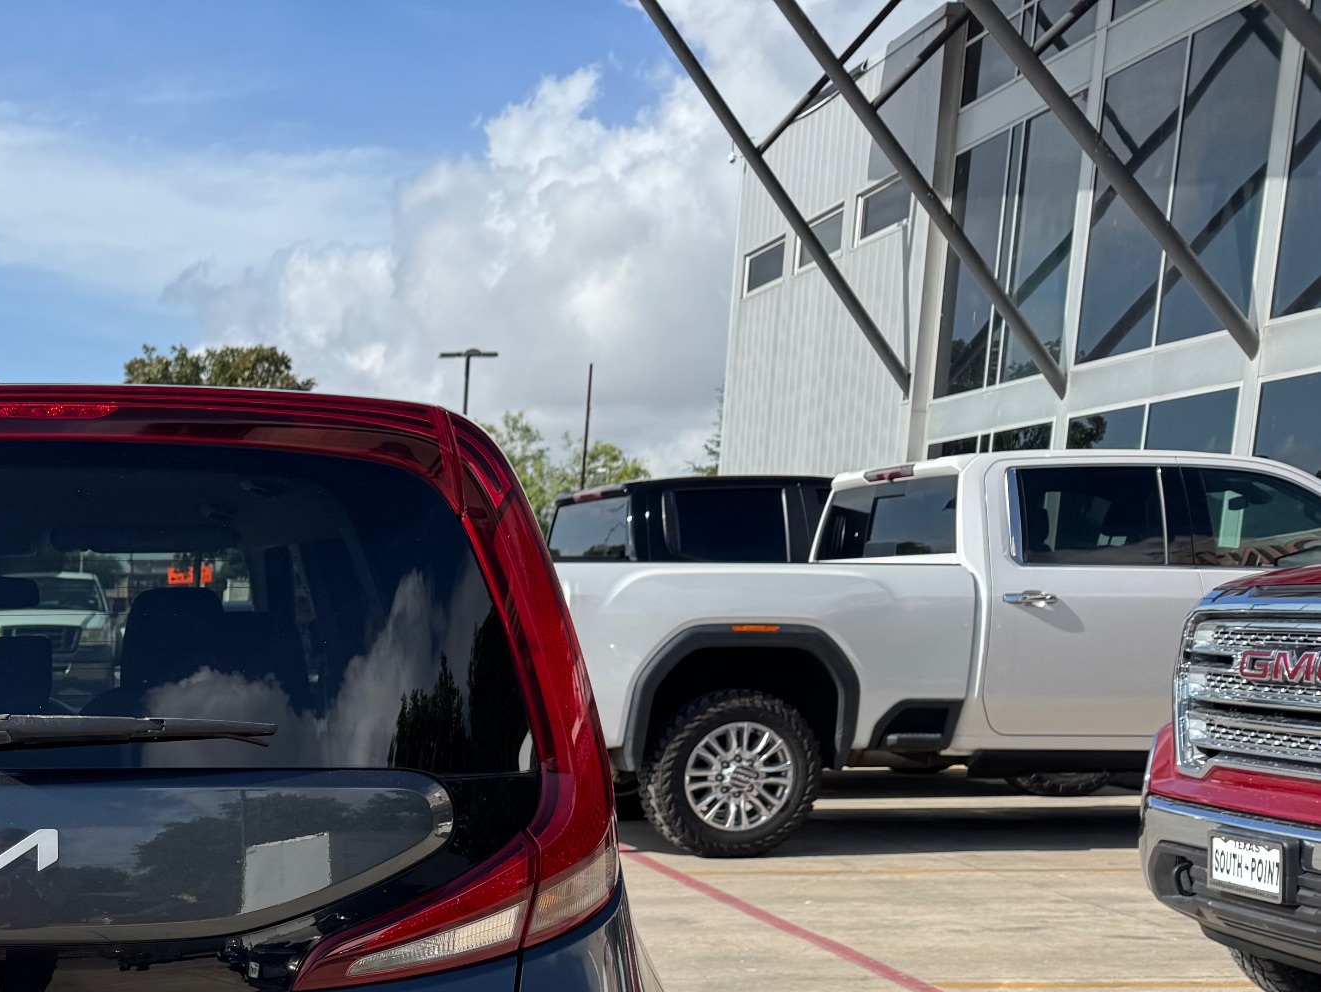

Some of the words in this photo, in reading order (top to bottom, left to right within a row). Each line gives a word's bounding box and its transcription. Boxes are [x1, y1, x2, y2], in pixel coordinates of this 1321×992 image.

[1239, 650, 1321, 684] GM
[1234, 841, 1261, 853] TEXAS
[1214, 849, 1243, 878] SOUTH
[1250, 857, 1280, 886] POINT
